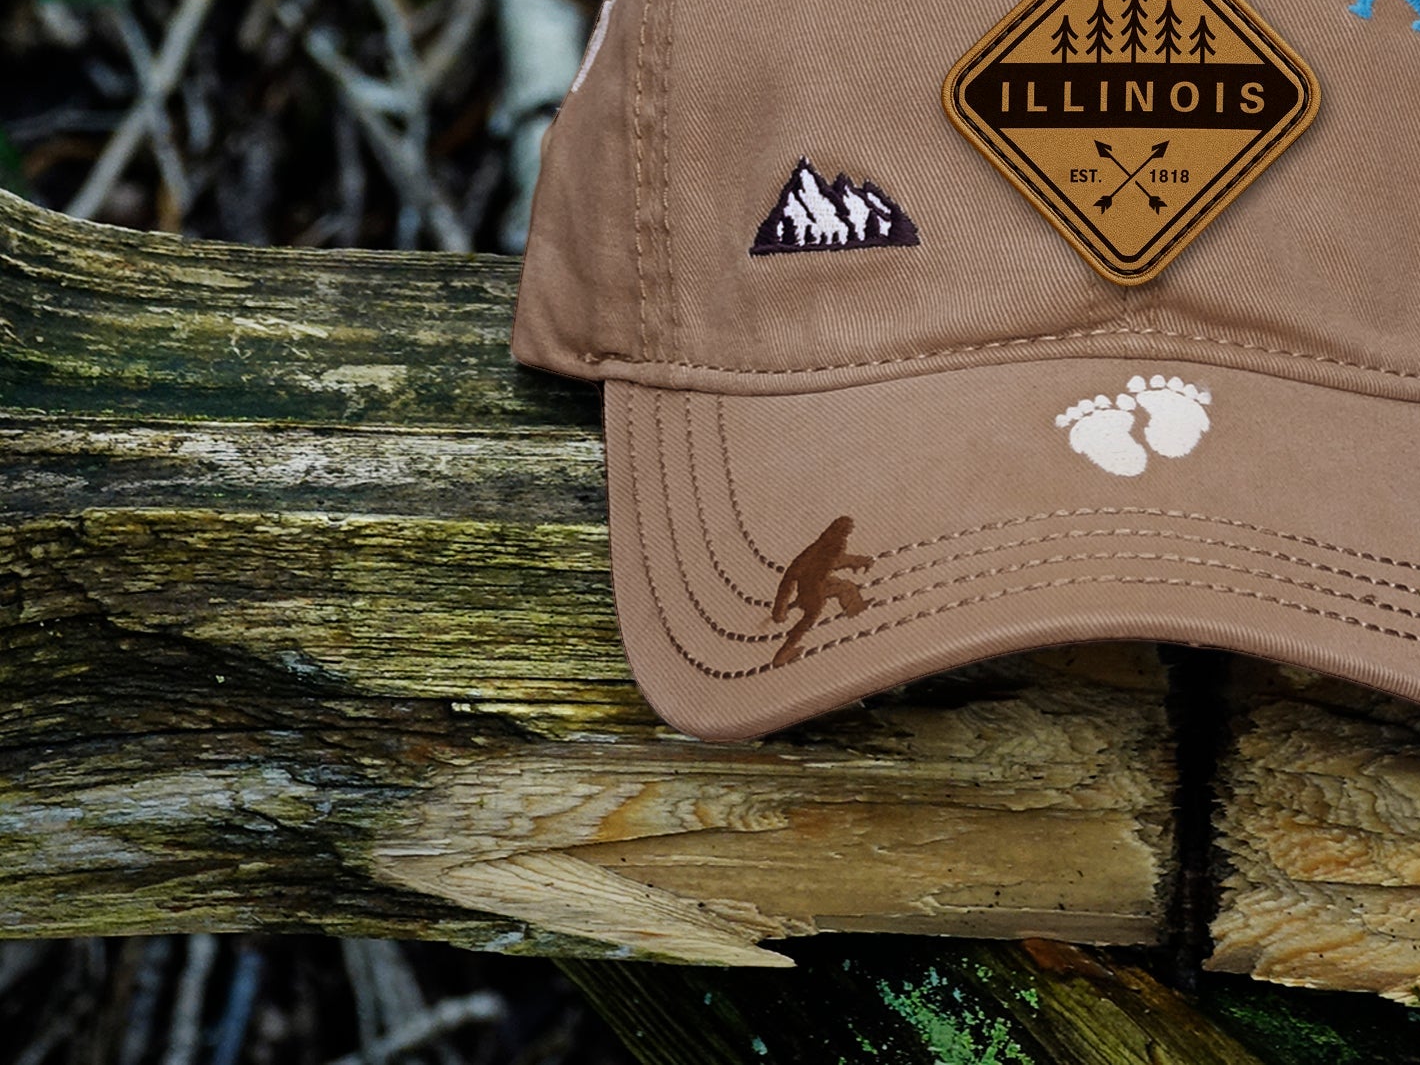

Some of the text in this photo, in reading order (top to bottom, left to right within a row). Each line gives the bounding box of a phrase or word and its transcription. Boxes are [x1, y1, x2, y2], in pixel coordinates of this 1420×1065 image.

[1001, 80, 1265, 114] ILLINOIS
[1069, 168, 1190, 184] EST. 1818
